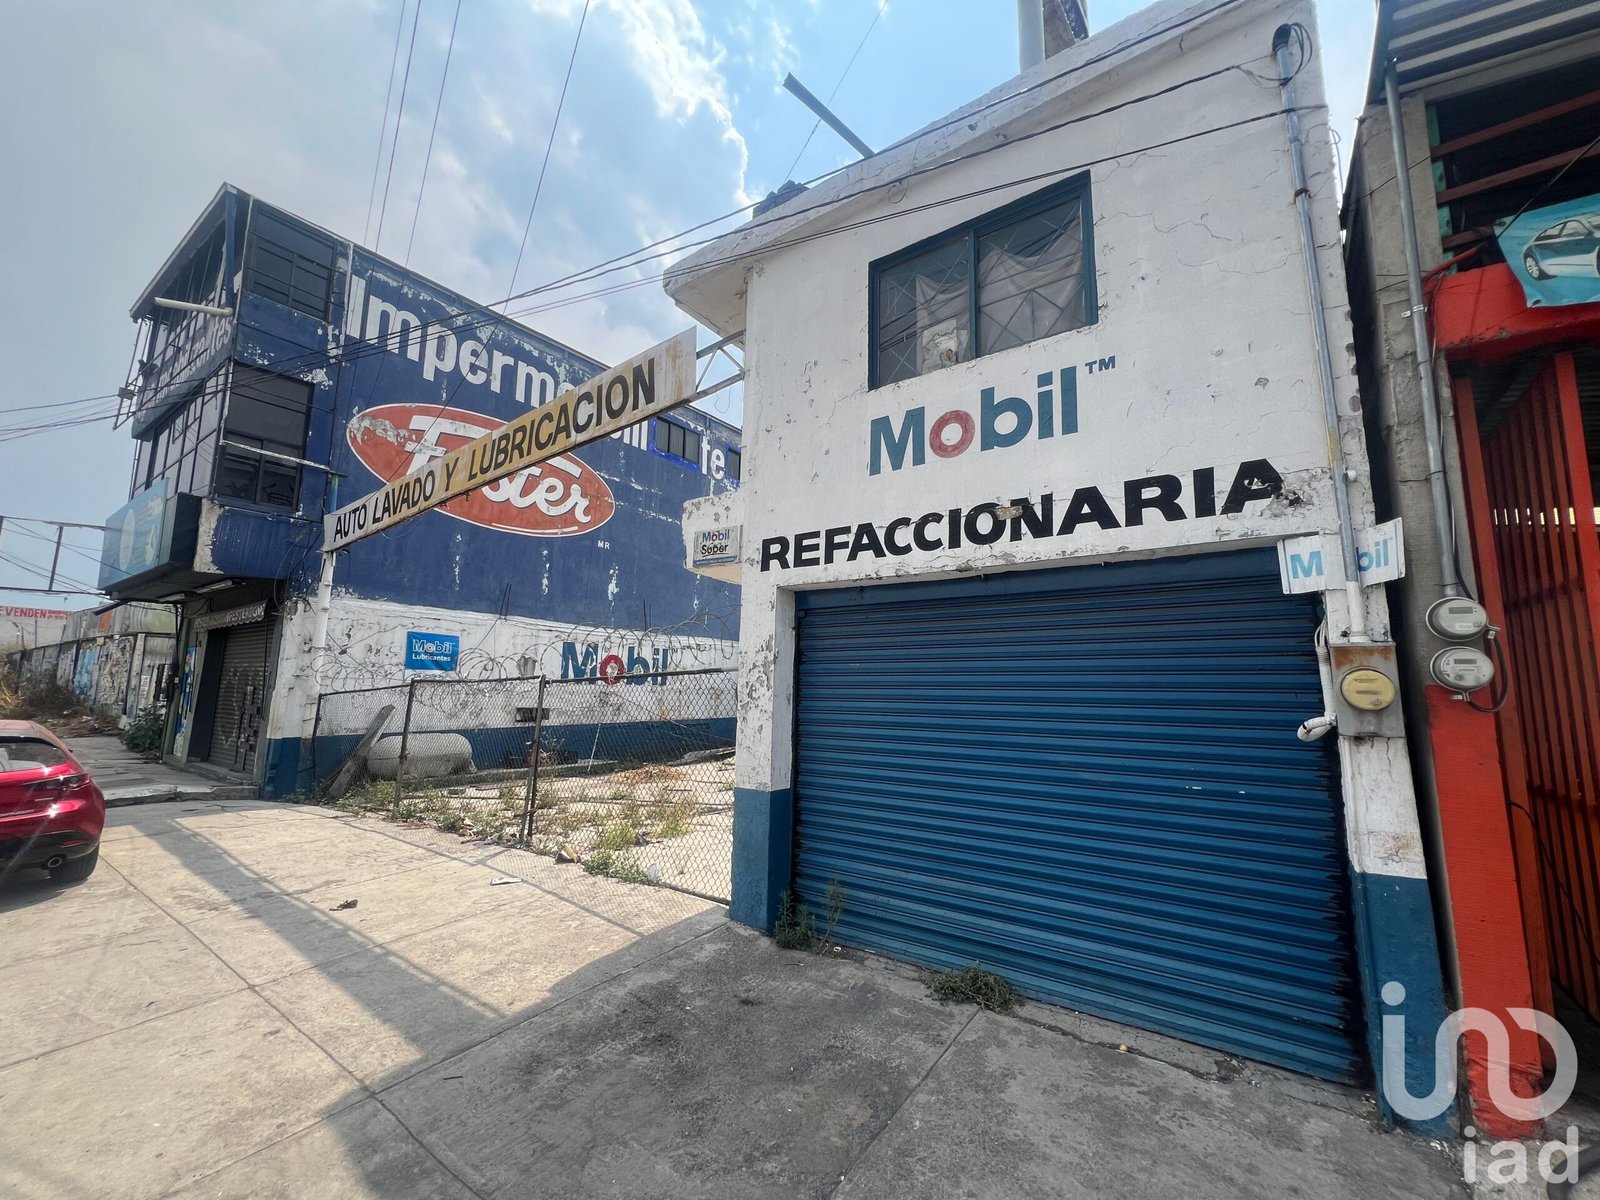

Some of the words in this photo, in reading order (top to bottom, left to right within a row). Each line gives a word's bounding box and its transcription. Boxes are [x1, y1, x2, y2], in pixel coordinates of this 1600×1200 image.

[869, 365, 1079, 476] Mobil
[1085, 355, 1116, 374] TM
[333, 508, 367, 543] AUTO
[372, 469, 436, 522] LAVADO
[444, 457, 461, 491] Y
[467, 357, 656, 482] LUBRICACION
[403, 415, 591, 523] Fster
[760, 458, 1300, 572] REFACCIONARIA
[597, 539, 610, 550] MR
[702, 529, 730, 542] Mobil
[1290, 539, 1389, 579] Mbil
[5, 606, 47, 619] VENDEN
[412, 639, 453, 654] Mobil
[412, 653, 452, 662] Lubricantes
[561, 641, 669, 686] Mobil
